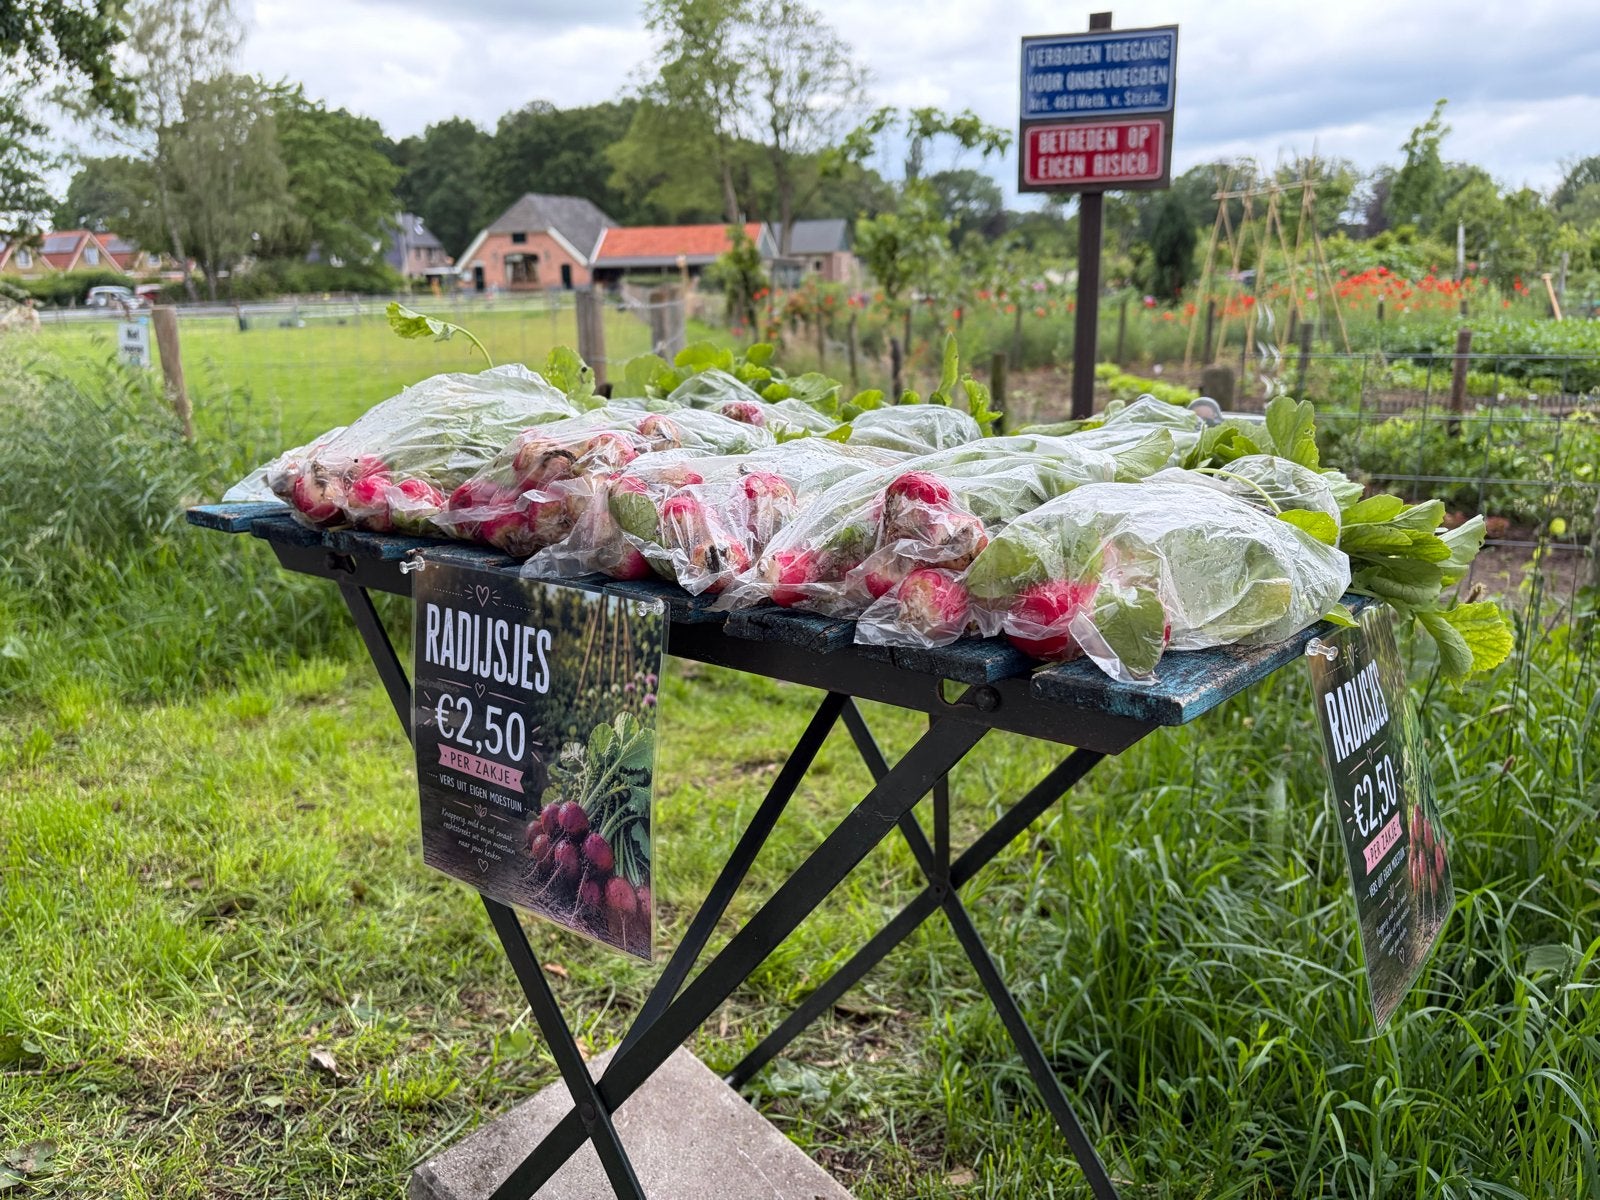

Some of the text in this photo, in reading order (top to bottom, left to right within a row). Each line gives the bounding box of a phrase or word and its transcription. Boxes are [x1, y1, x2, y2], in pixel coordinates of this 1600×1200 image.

[1028, 39, 1169, 67] VERBODEN TOEGANG
[1027, 66, 1168, 93] VOOR ONBEVOEGDEN
[1038, 126, 1150, 154] BETREDEN OP
[1038, 151, 1149, 178] EIGEN RISICO
[425, 602, 552, 694] RADIJSJES
[435, 693, 526, 762] €2,50
[1325, 659, 1389, 763] RADIJSJES
[450, 751, 510, 784] PER ZAKJE
[440, 773, 522, 813] VERS UIT EIGEN MOESTUIN
[1354, 754, 1397, 837] €2,50
[1369, 821, 1398, 864] PER ZAKJE
